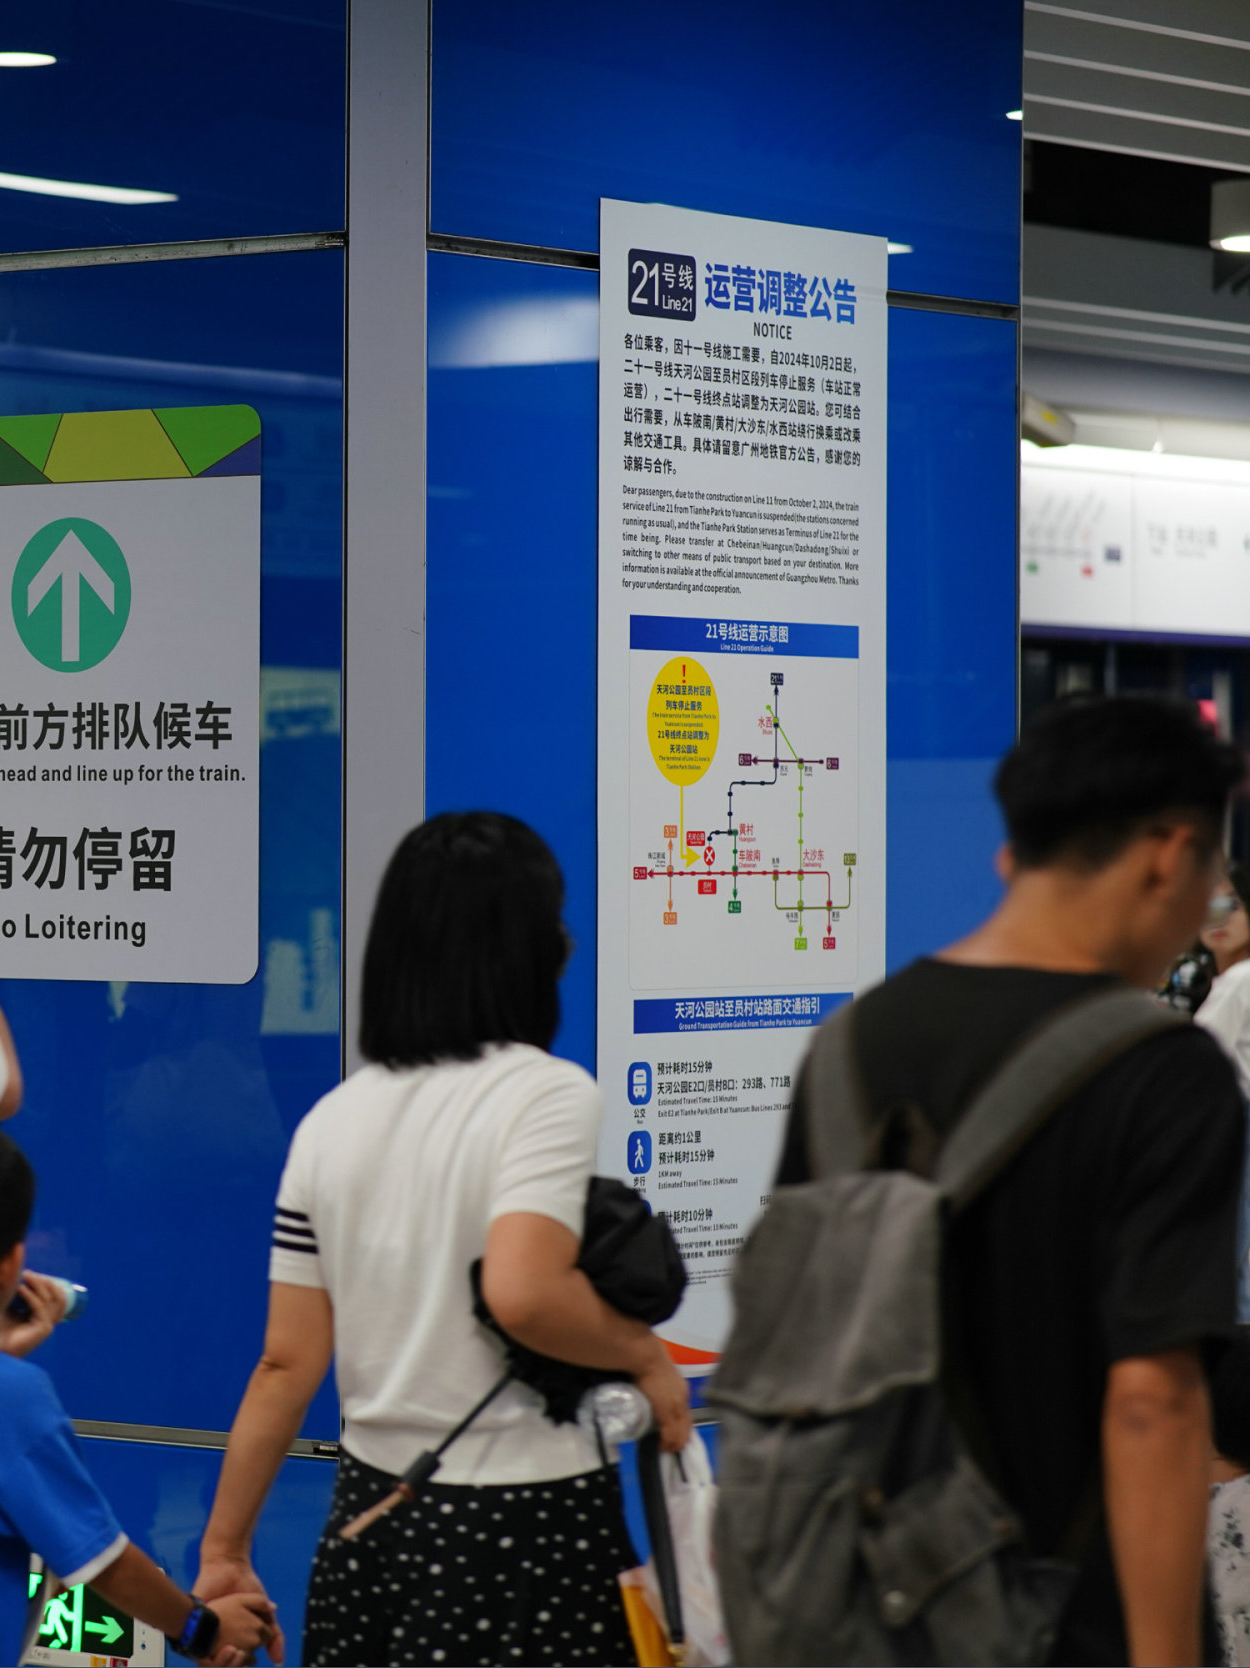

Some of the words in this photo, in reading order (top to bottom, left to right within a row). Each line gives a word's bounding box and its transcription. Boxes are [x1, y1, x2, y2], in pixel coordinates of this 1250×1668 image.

[631, 261, 659, 307] 21
[662, 262, 694, 291] 号线
[704, 262, 857, 325] 运营调整公告
[662, 295, 682, 311] Line
[681, 297, 693, 312] 21
[753, 322, 793, 340] NOTICE
[623, 485, 637, 495] Dear
[638, 488, 674, 499] passengers,
[706, 492, 743, 502] construction
[752, 494, 765, 504] Line
[774, 496, 788, 505] from
[789, 497, 811, 507] October
[845, 501, 859, 510] train
[623, 502, 644, 511] service
[652, 503, 665, 512] Line
[674, 505, 689, 514] from
[690, 506, 710, 516] Tianhe
[711, 507, 724, 517] Park
[731, 509, 757, 519] Yuancun
[807, 514, 830, 524] stations
[830, 517, 859, 526] concerned
[623, 518, 647, 529] running
[700, 522, 721, 531] Tianhe
[722, 523, 736, 532] Park
[737, 524, 758, 534] Station
[759, 527, 777, 535] serves
[786, 527, 812, 537] Terminus
[623, 532, 637, 541] time
[664, 534, 685, 544] Please
[689, 536, 714, 546] transfer
[623, 548, 652, 560] switching
[664, 550, 680, 560] other
[682, 553, 702, 561] means
[713, 553, 731, 564] public
[734, 554, 761, 566] transport
[764, 556, 781, 566] based
[793, 560, 806, 569] your
[808, 559, 842, 569] destination.
[845, 561, 859, 570] More
[623, 563, 659, 573] information
[666, 566, 694, 575] available
[713, 568, 734, 578] official
[734, 571, 778, 580] announcement
[786, 572, 818, 584] Guangzhou
[819, 574, 837, 584] Metro.
[839, 575, 859, 585] Thanks
[632, 581, 646, 590] your
[647, 580, 691, 593] understanding
[704, 584, 741, 594] cooperation.
[706, 622, 788, 643] 21号线运营示意图
[737, 644, 759, 652] Operation
[758, 716, 772, 728] 水西
[41, 765, 71, 782] and
[77, 765, 108, 781] line
[113, 768, 134, 786] up
[138, 765, 163, 781] for
[167, 765, 195, 781] the
[199, 765, 246, 781] train.
[739, 824, 753, 836] 黄村
[803, 849, 824, 861] 大沙东
[25, 914, 147, 947] Loitering
[674, 997, 820, 1019] 天河公园站至员村站路面交通指引
[657, 1061, 713, 1075] 预计耗时15分钟
[633, 1108, 646, 1118] 公交
[658, 1131, 702, 1145] 距离约1公里
[658, 1149, 715, 1165] 预计耗时15分钟
[633, 1176, 646, 1187] 步行
[658, 1208, 713, 1224] 计耗时10分钟
